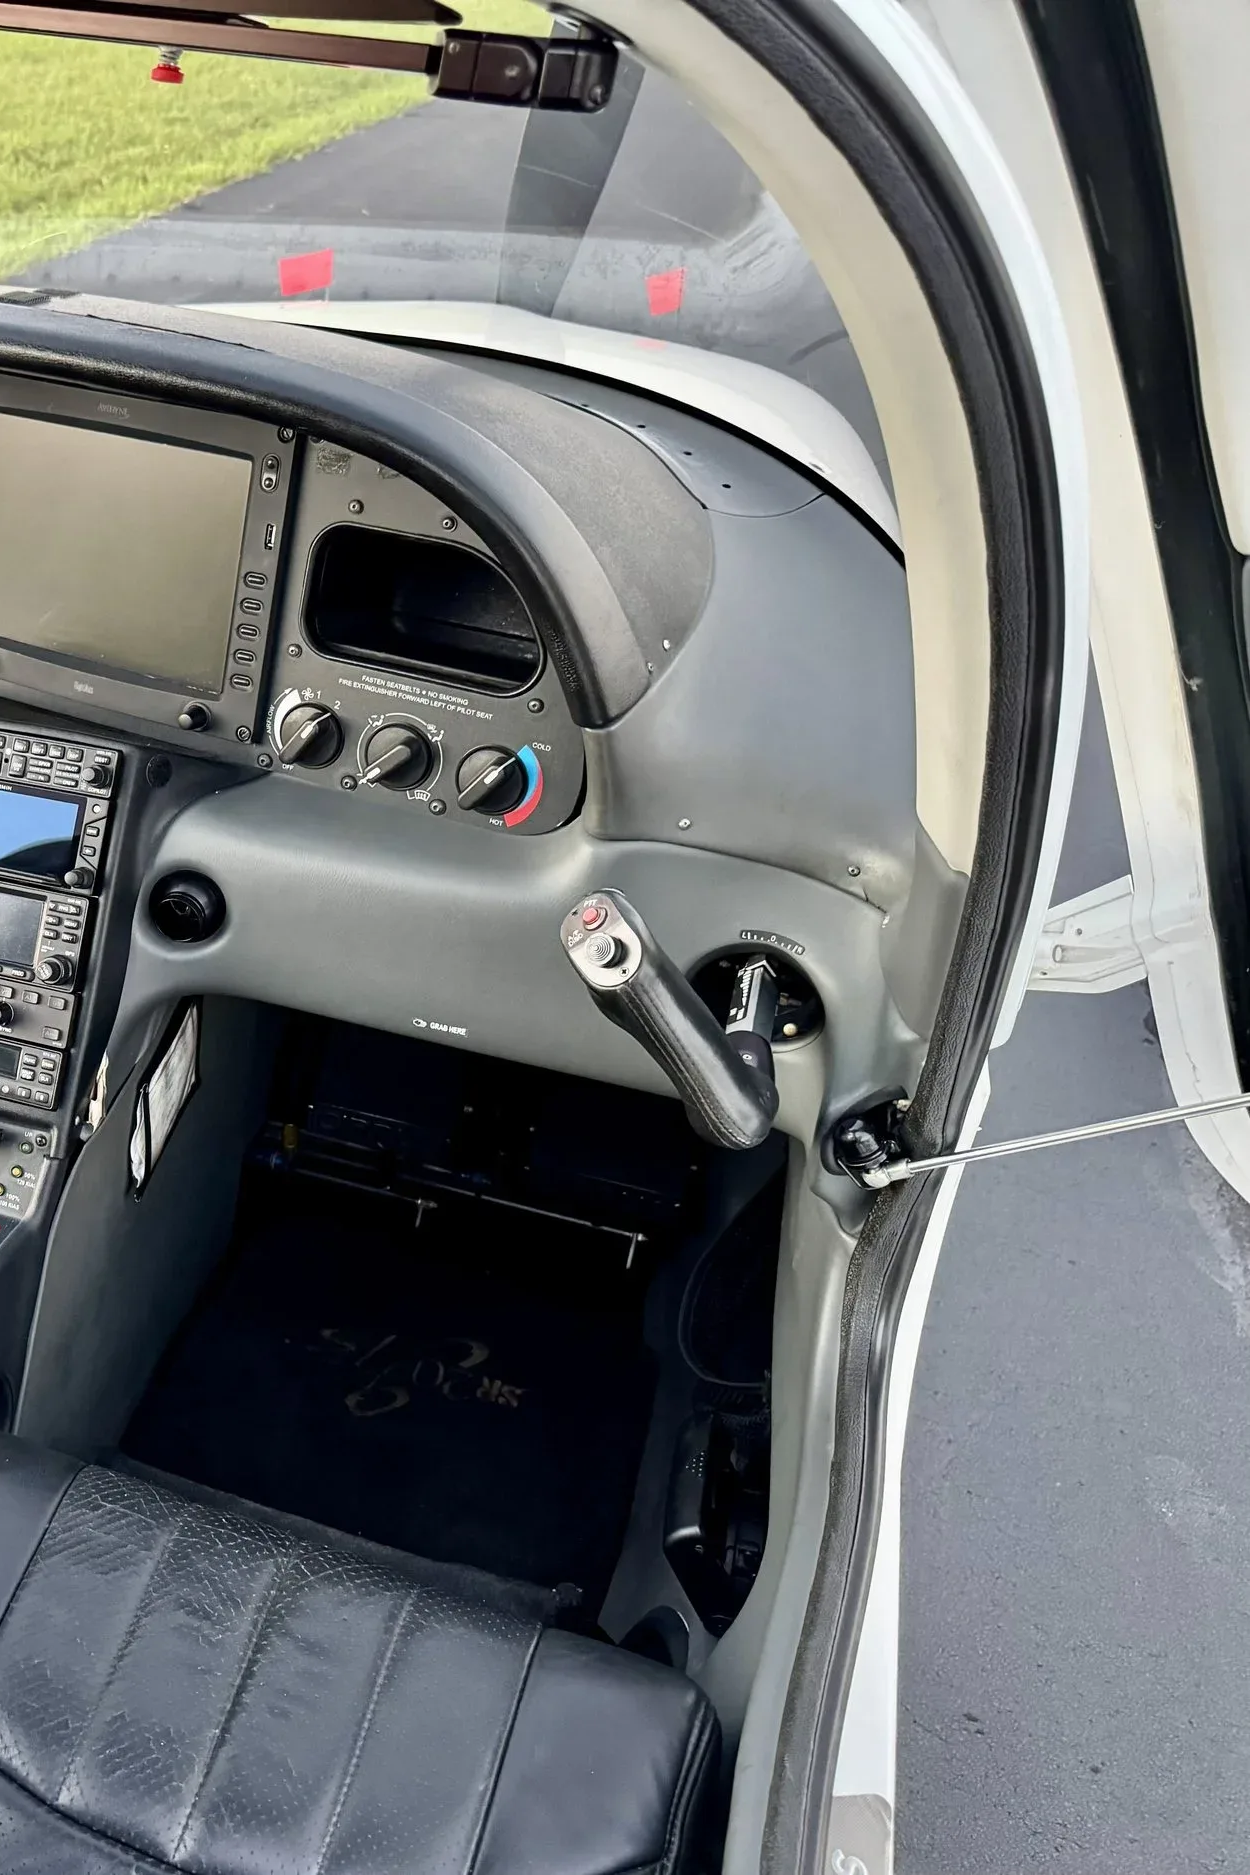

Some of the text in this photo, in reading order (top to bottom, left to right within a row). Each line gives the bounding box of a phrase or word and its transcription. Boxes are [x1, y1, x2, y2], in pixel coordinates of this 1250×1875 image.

[316, 690, 321, 699] 1
[362, 674, 469, 706] FASTEN SEATBELTS NO SMOKING
[338, 678, 494, 720] FIRE EXTINGUISHER FORWARD LEFT OF PILOT SEAT
[334, 700, 341, 710] 2
[266, 704, 275, 734] AIRFLOW
[532, 742, 551, 752] COLD
[489, 818, 503, 827] HOT
[583, 899, 598, 908] PTT
[430, 1021, 466, 1035] GRAB HERE
[6, 1193, 20, 1202] 100%
[8, 1202, 20, 1210] KIAS
